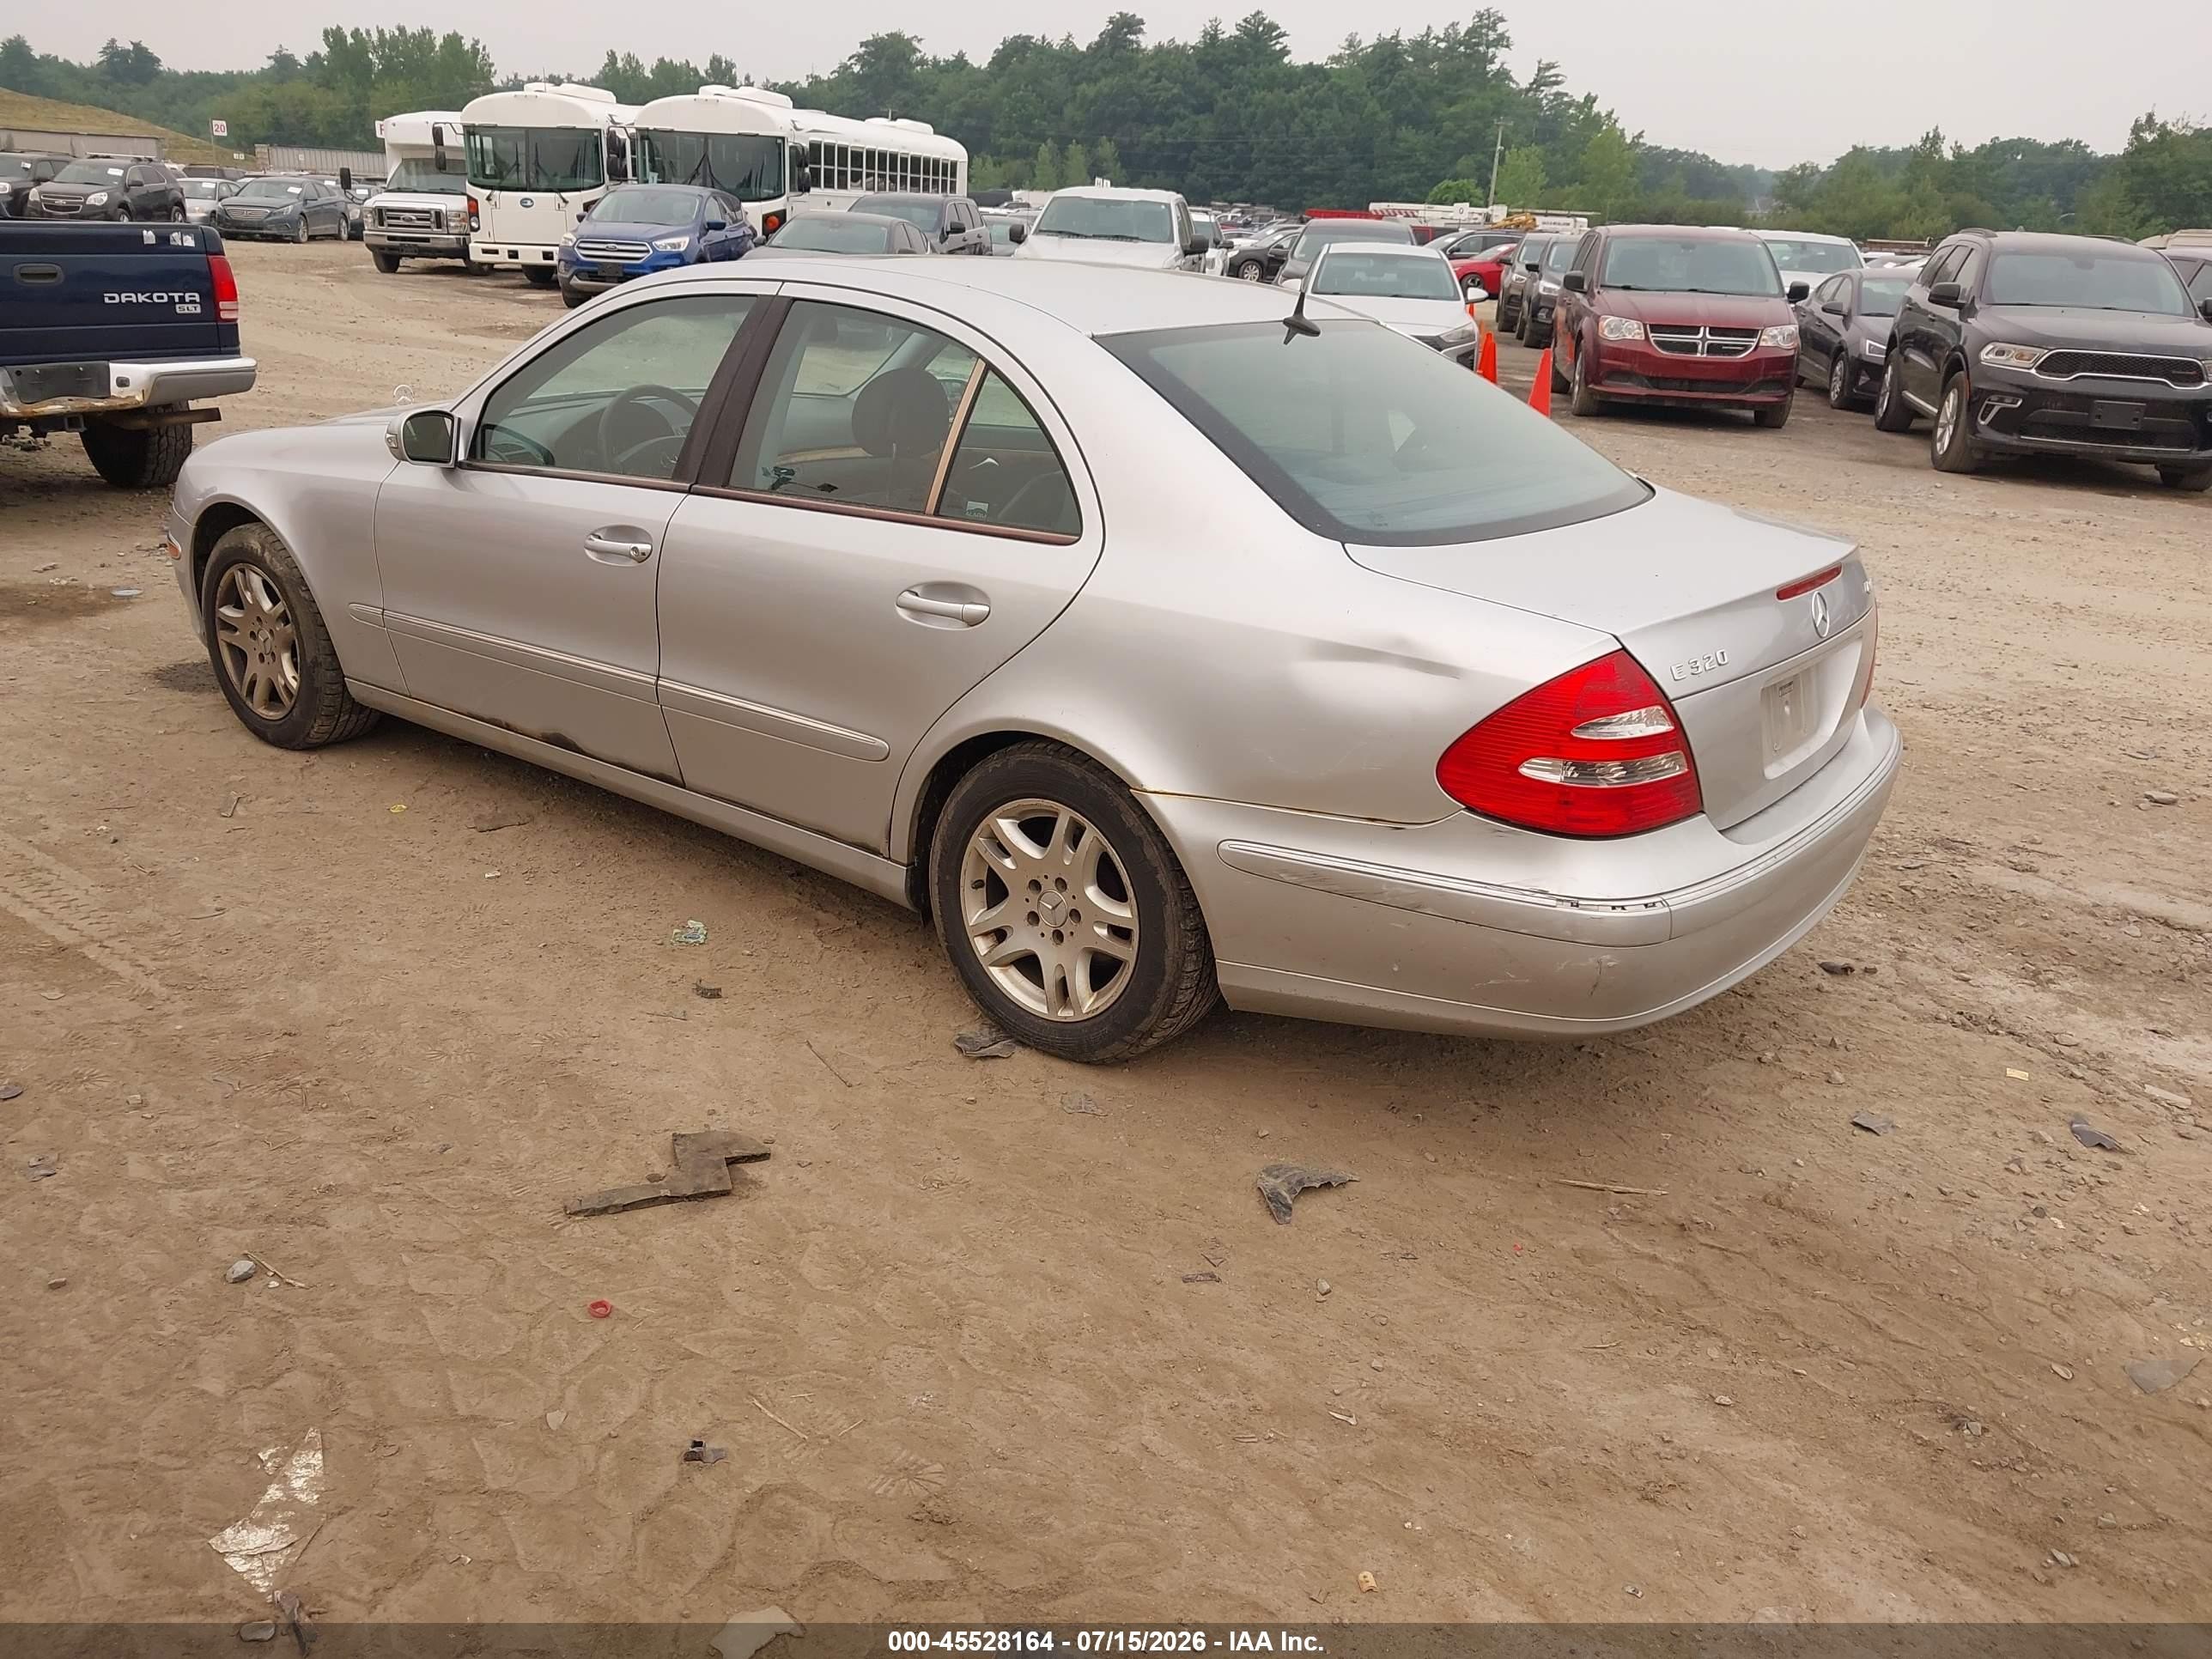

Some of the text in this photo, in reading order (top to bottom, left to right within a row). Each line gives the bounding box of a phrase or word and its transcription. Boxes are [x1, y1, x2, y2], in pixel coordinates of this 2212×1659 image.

[215, 124, 226, 133] 20
[103, 293, 200, 303] DAKOTA
[1670, 648, 1729, 681] E 320
